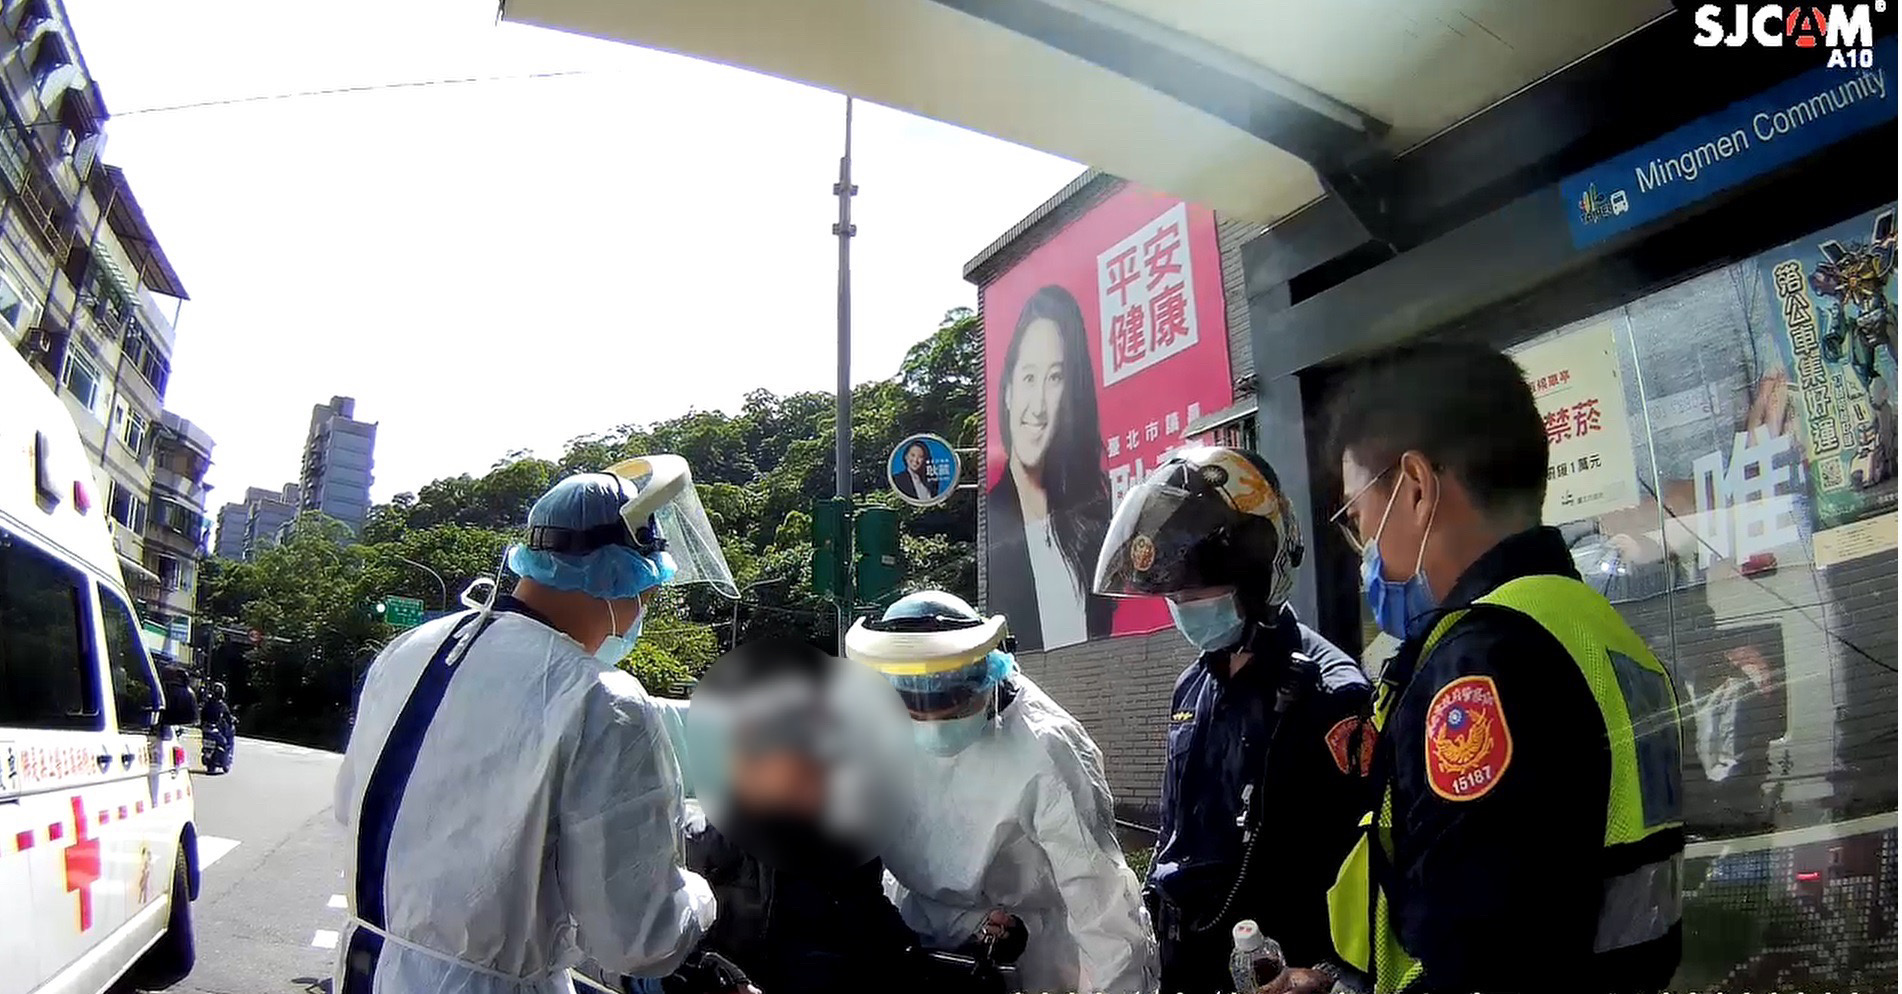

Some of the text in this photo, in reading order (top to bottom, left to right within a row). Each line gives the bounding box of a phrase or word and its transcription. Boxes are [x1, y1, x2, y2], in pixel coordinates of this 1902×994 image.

[1635, 67, 1887, 193] Mingmen Community
[1105, 221, 1182, 307] 平安
[1108, 280, 1189, 373] 健康
[1544, 399, 1602, 444] 禁菸
[1452, 765, 1491, 793] 15187
